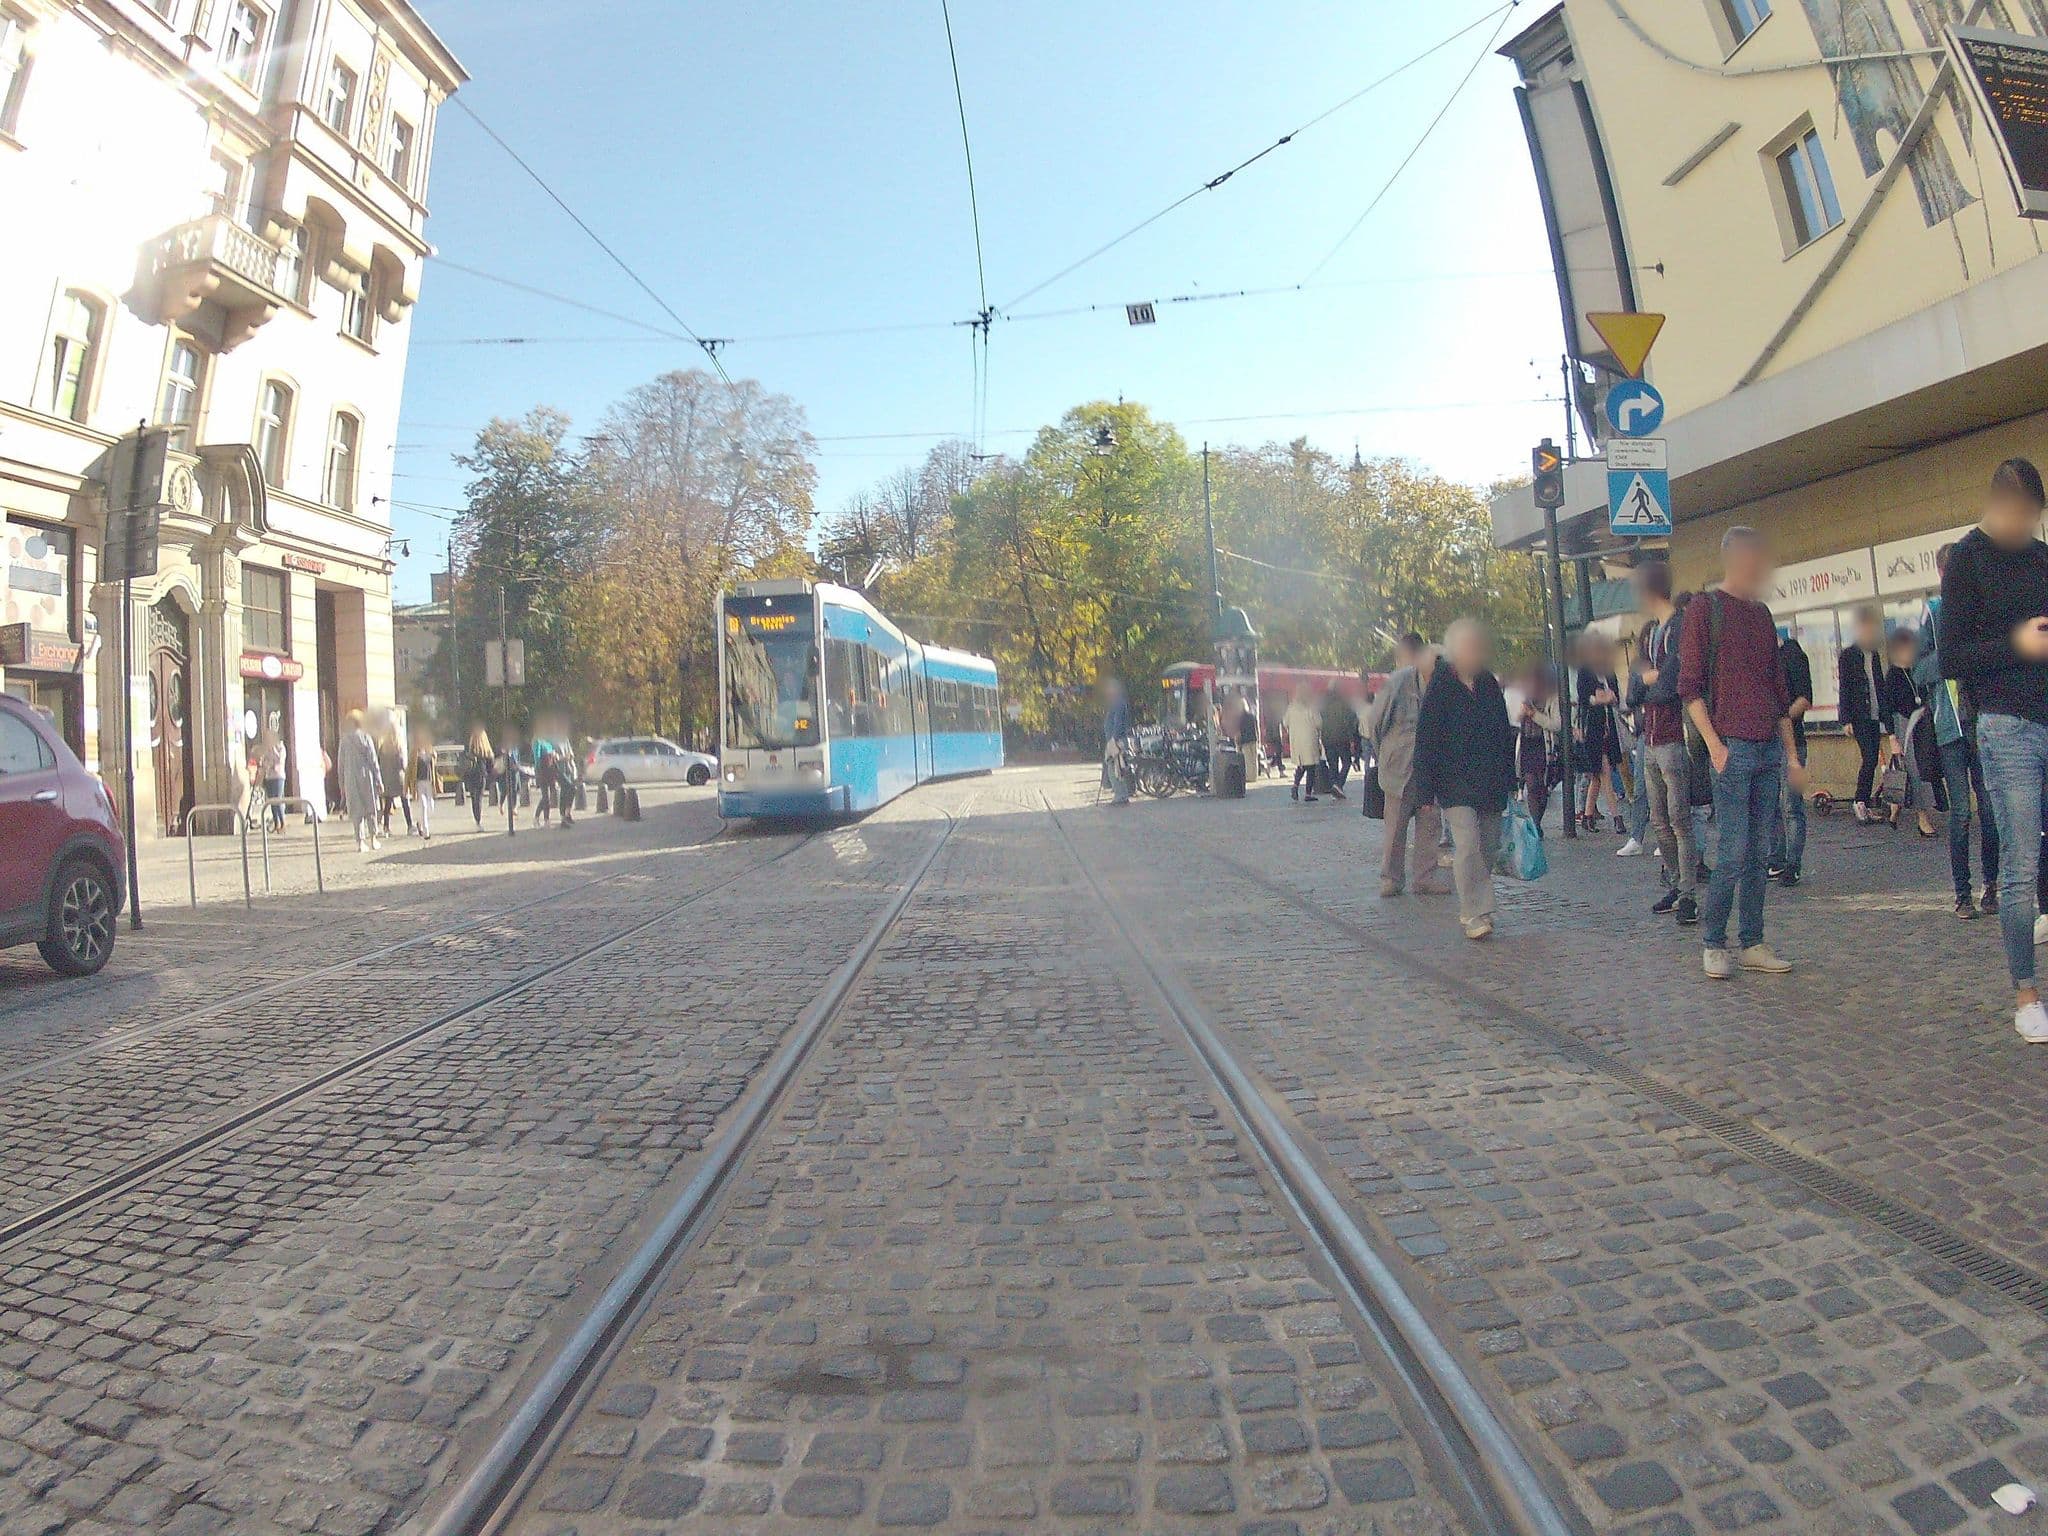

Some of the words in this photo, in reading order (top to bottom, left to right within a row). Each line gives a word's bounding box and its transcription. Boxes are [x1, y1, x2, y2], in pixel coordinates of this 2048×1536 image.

[1789, 577, 1808, 596] 1919
[1810, 572, 1830, 593] 2019
[38, 642, 79, 664] Exchang
